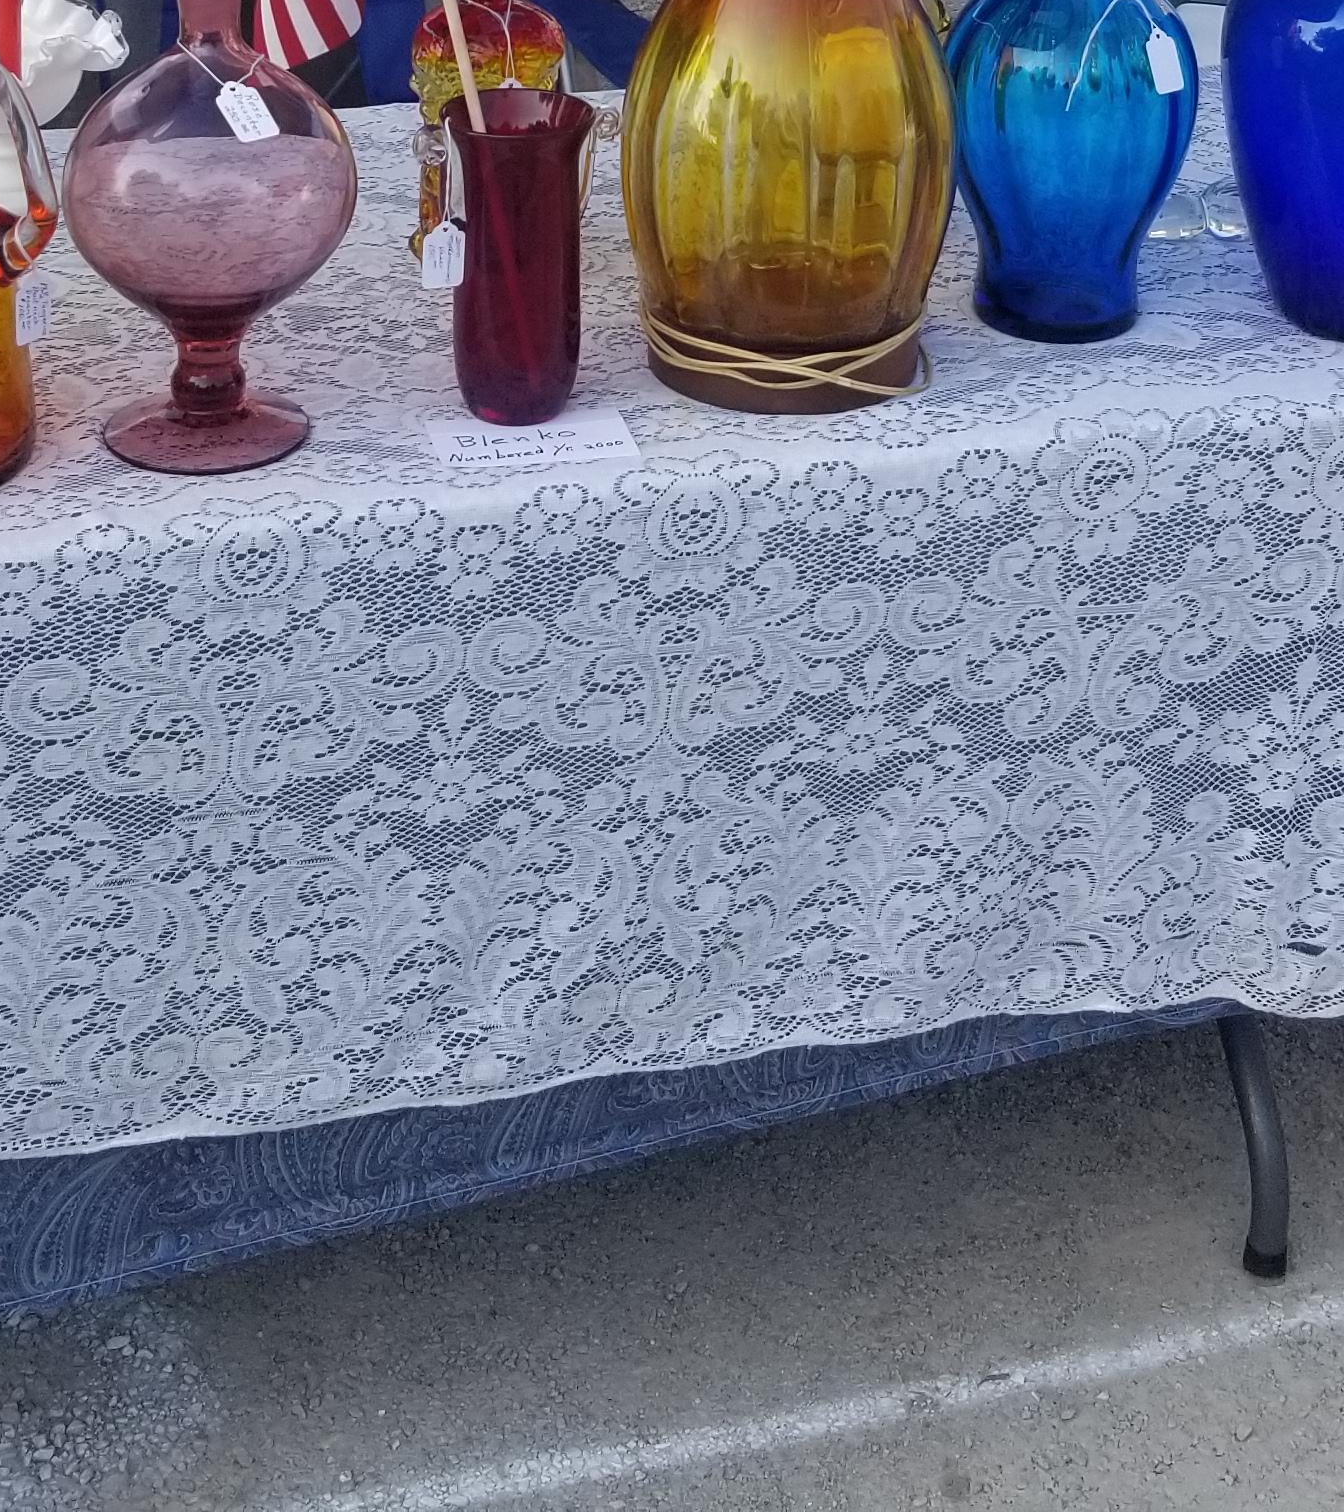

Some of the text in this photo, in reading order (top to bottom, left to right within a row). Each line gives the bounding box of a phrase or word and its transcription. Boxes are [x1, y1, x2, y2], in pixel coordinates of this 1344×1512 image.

[453, 429, 576, 448] Blenko
[449, 445, 544, 463] Numbered
[583, 440, 624, 449] 2000
